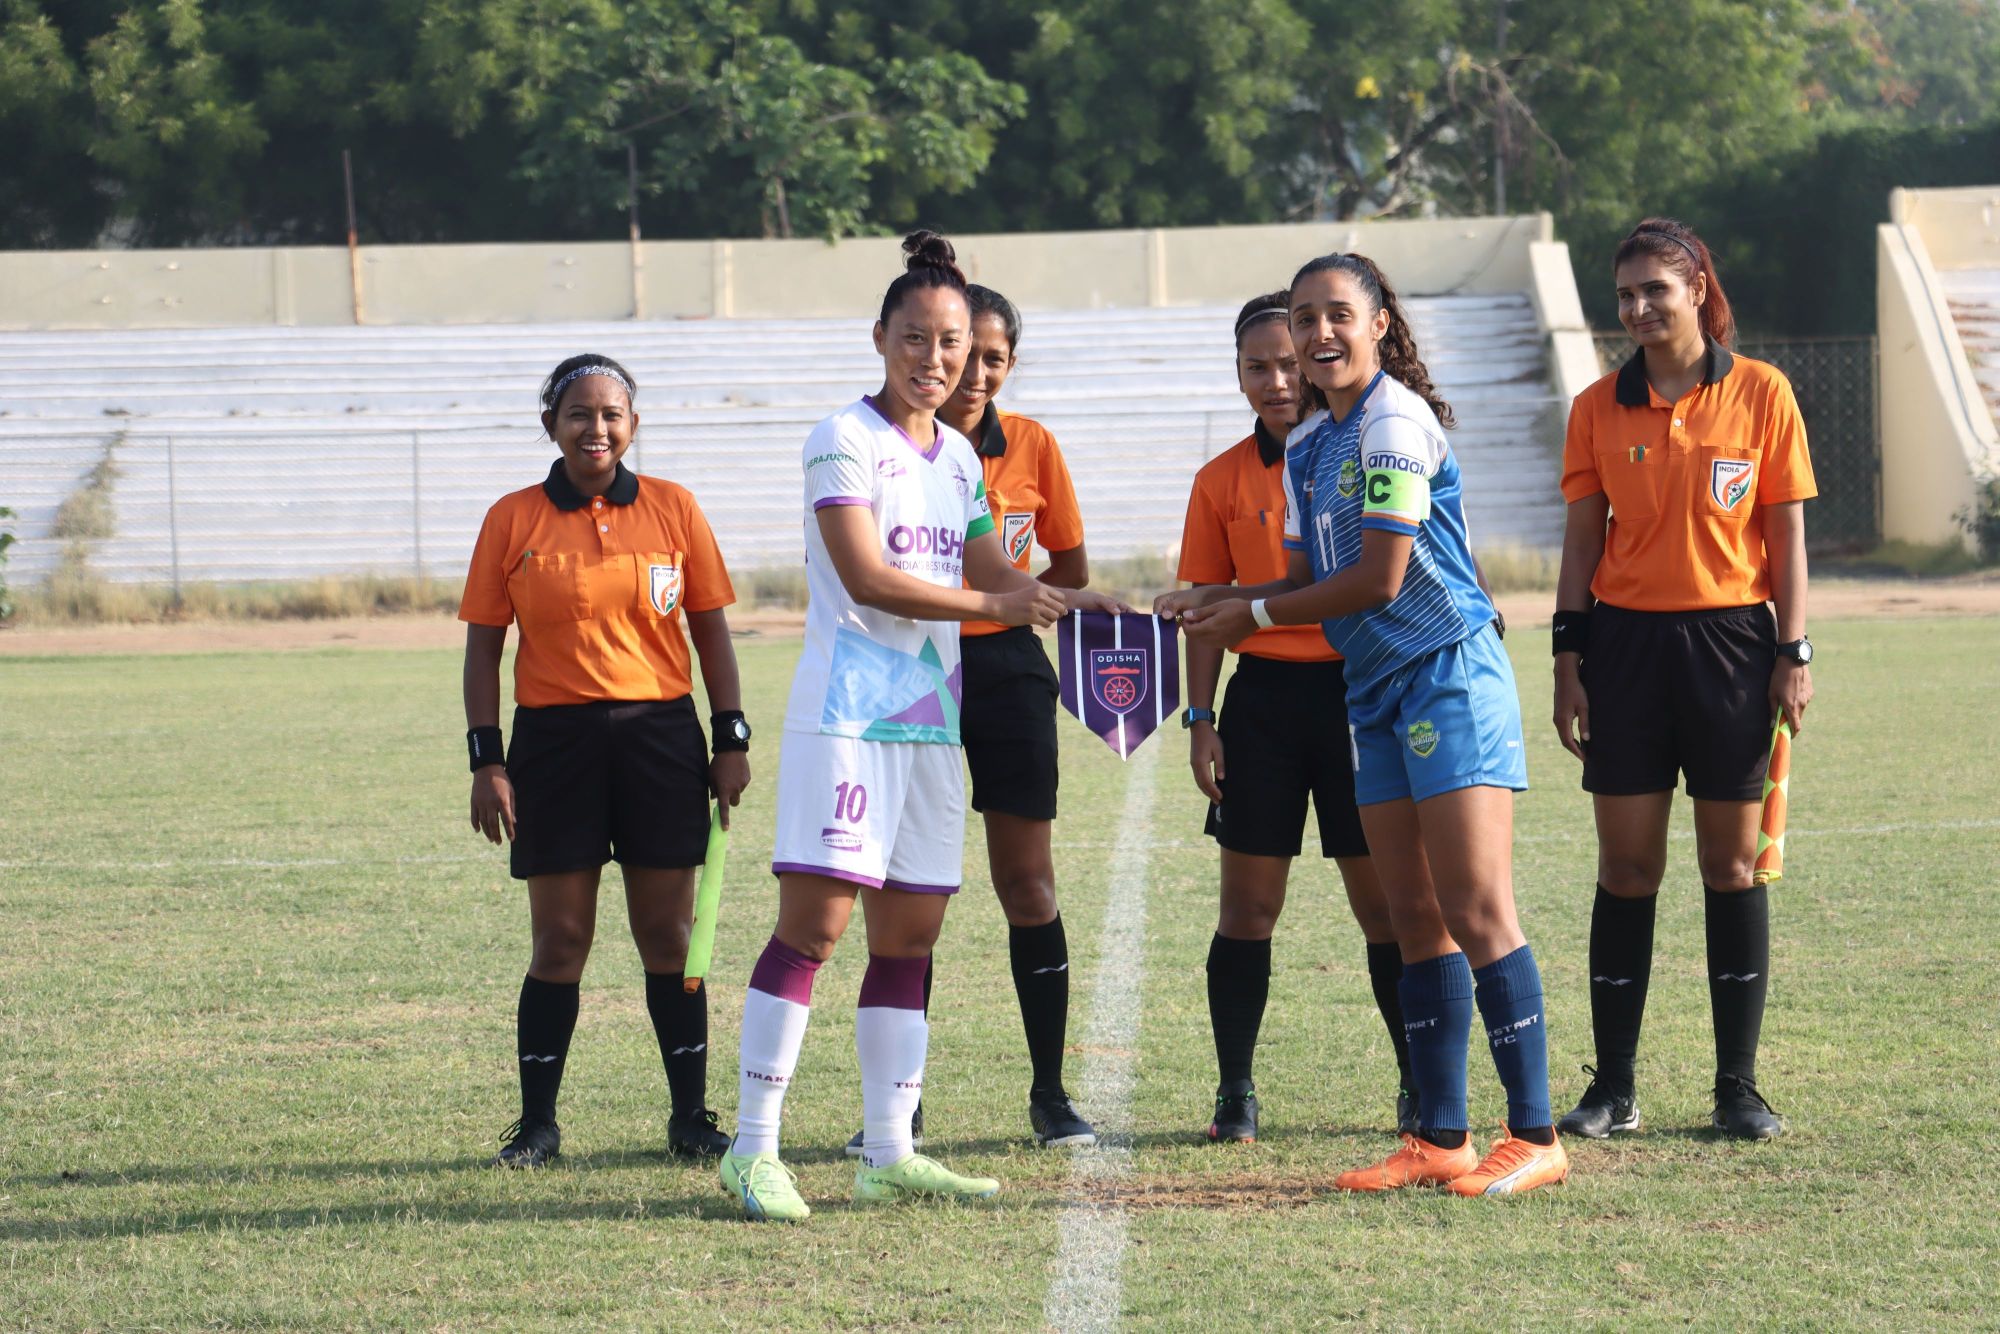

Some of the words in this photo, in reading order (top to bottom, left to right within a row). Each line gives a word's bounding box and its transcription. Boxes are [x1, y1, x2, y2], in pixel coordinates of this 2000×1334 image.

[1718, 465, 1740, 473] INDIA
[1367, 473, 1392, 505] C
[1315, 511, 1338, 572] 17
[1097, 654, 1141, 663] ODISHA
[834, 780, 867, 824] 10
[1494, 1034, 1517, 1048] FC
